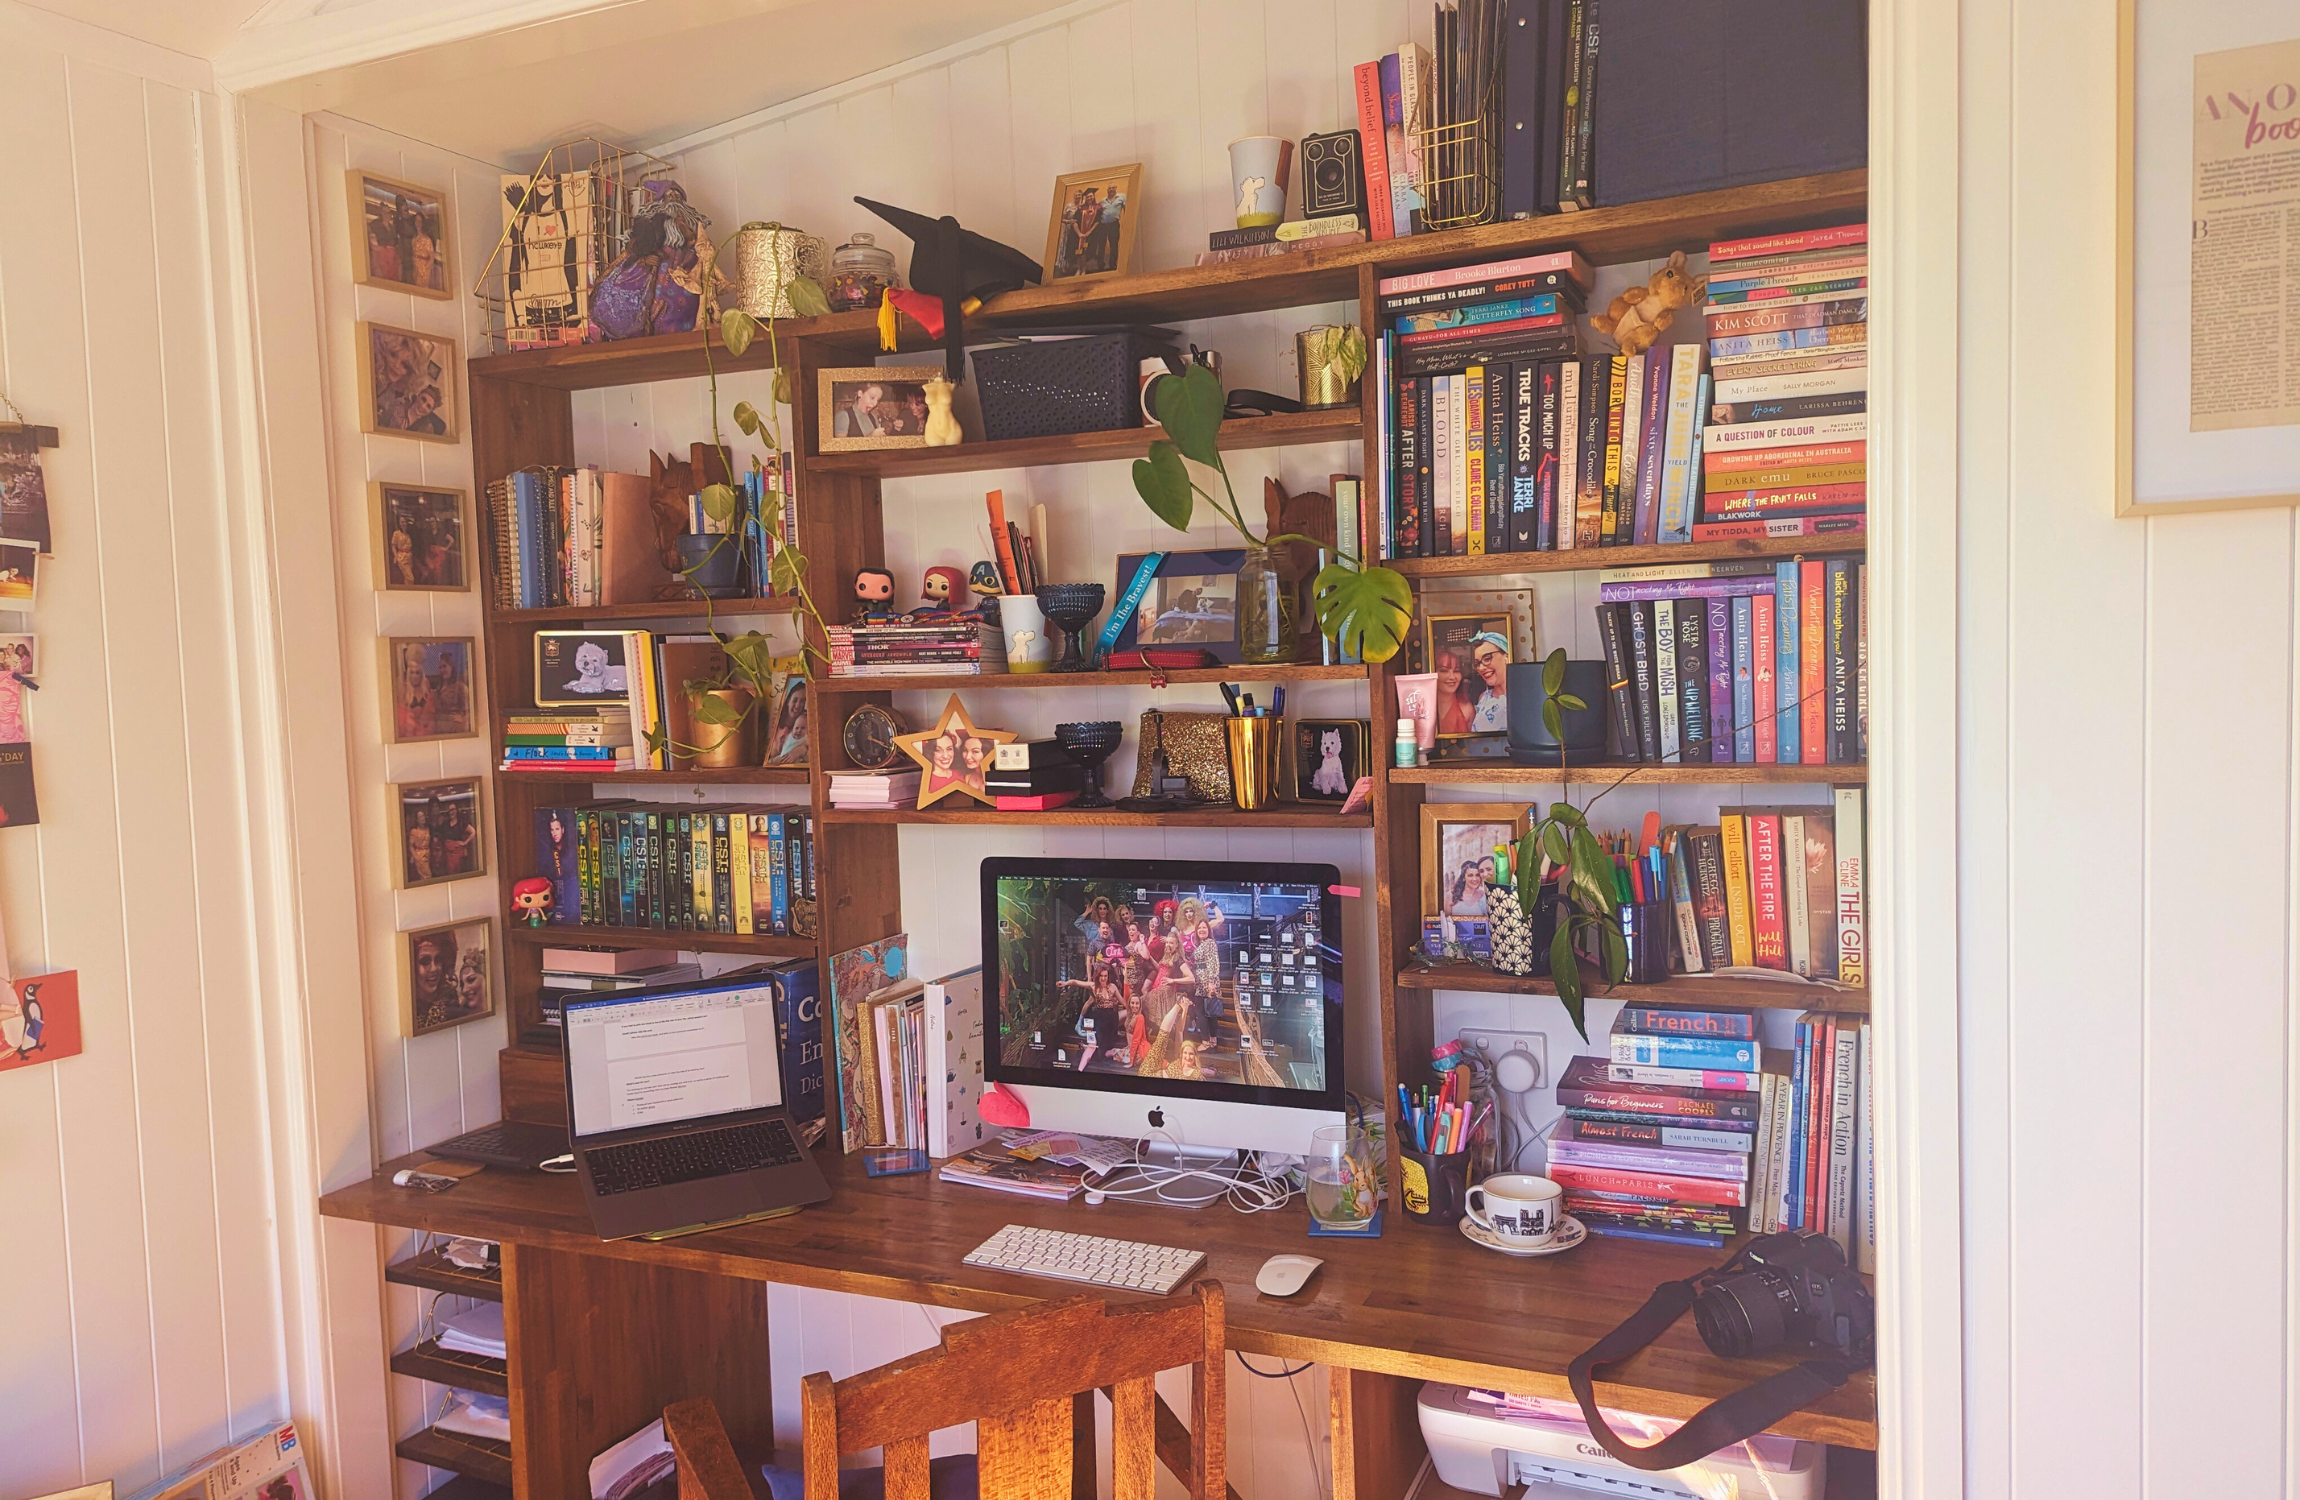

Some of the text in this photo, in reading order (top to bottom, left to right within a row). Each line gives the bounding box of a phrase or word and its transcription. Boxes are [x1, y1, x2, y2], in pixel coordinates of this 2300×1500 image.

[1587, 24, 1600, 59] CSI:
[1361, 66, 1374, 103] beyond
[1366, 104, 1377, 133] belief
[1392, 170, 1400, 210] SALAMAN
[1212, 229, 1270, 248] LILI WILKINSON
[1300, 225, 1308, 238] THE
[1308, 218, 1342, 233] BOUNDLESS
[1810, 230, 1864, 244] Jared Thomas
[1291, 240, 1324, 250] PEGGY
[1391, 272, 1436, 292] BIG LOVE
[1454, 263, 1521, 280] Brooke Blurton
[1494, 278, 1536, 292] COREY TUTT
[1386, 286, 1486, 308] THIS BOOK THINKS YA DEADLY!
[1470, 305, 1536, 321] BUTTERFLY SONG
[1715, 313, 1789, 331] KIM SCOTT
[1718, 336, 1788, 350] ANITA HEISS
[1730, 385, 1768, 396] My Place
[1783, 379, 1836, 390] SALLY MORGAN
[1492, 373, 1504, 448] Anita Heiss
[1518, 368, 1532, 462] TRUE TRACKS
[1586, 360, 1600, 441] Nardi Simpson Song
[1436, 396, 1446, 459] BLOOD
[1607, 382, 1623, 472] BORN INTO THIS
[1664, 348, 1695, 532] TARA JUNE WINCH
[1716, 425, 1815, 442] A QUESTION OF COLOUR
[1402, 429, 1416, 511] AFTER STORY
[1722, 455, 1754, 464] GROWING
[1754, 454, 1763, 462] UP
[1764, 451, 1806, 460] ABORIGINAL
[1815, 446, 1852, 456] AUSTRALIA
[1586, 450, 1598, 495] Crocodile
[1724, 472, 1790, 486] DARK emu
[1806, 470, 1835, 479] BRUCE
[1340, 490, 1349, 509] your
[1514, 476, 1524, 514] JANKE
[1522, 474, 1534, 508] TERRI
[1724, 492, 1818, 511] WHERE THE FRUIT FALLS
[1718, 510, 1762, 520] BLAKWORK
[1722, 527, 1751, 536] TIDDA,
[1753, 526, 1766, 534] MY
[1768, 524, 1799, 533] SISTER
[1342, 528, 1352, 548] kind
[1106, 564, 1153, 638] I'm The Bravest!
[1658, 608, 1674, 654] THE BOY
[1682, 620, 1690, 644] ROSE
[1688, 614, 1698, 649] LYSTRA
[1632, 611, 1650, 692] GHOST BIRD
[1835, 657, 1846, 732] ANITA HEISS
[1642, 699, 1652, 742] LISA FULLER
[1684, 688, 1704, 742] UPWELLING
[579, 845, 588, 886] CSI:
[622, 836, 632, 870] CSI:
[636, 837, 648, 870] CSI:
[650, 836, 659, 869] CSI:
[668, 838, 677, 874] CSI:
[719, 837, 729, 874] CSI:
[774, 840, 785, 875] CSI:
[1728, 822, 1742, 880] will elliott
[1707, 858, 1719, 894] GREGG
[1757, 820, 1776, 922] AFTER THE FIRE
[1840, 860, 1850, 888] CLINE
[1848, 858, 1860, 888] EMMA
[1731, 885, 1746, 947] INSIDE OUT
[1708, 916, 1724, 956] PROGRAM
[1758, 931, 1782, 943] Will
[1758, 944, 1782, 958] Hill
[1839, 892, 1862, 984] THE GIRLS
[1646, 1011, 1718, 1032] French
[1834, 1040, 1854, 1156] French in Action
[1581, 1122, 1658, 1140] Almost French
[1669, 1133, 1729, 1144] SARAH TURNBULL
[1838, 1197, 1846, 1218] Method
[280, 1426, 297, 1452] MB
[232, 1474, 238, 1486] Up
